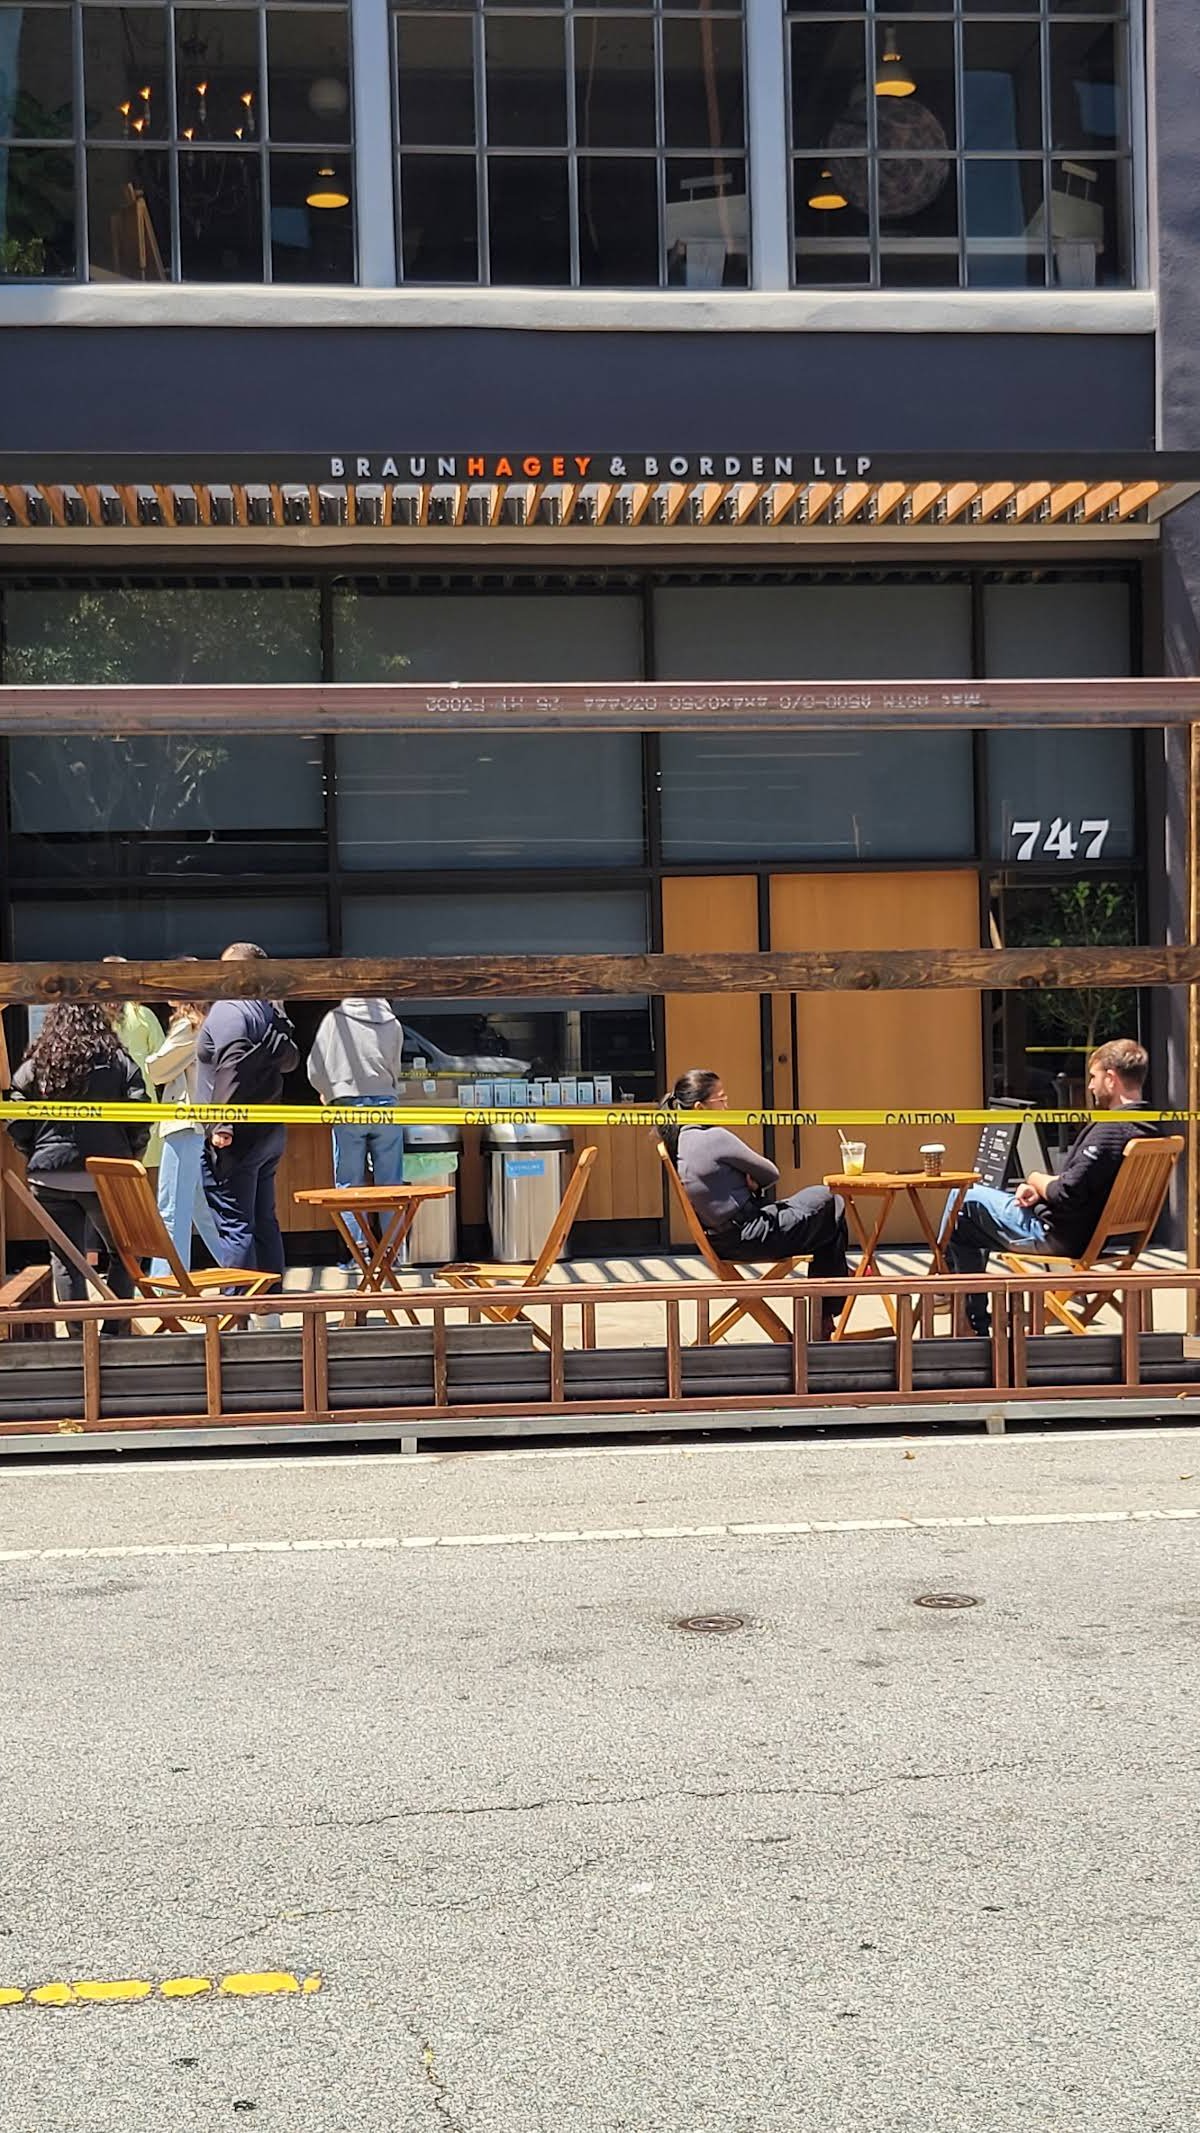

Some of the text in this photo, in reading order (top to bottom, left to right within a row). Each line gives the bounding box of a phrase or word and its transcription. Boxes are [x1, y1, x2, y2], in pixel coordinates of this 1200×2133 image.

[609, 457, 627, 477] &
[645, 457, 794, 477] BORDEN
[814, 457, 872, 476] LLP
[1011, 816, 1110, 861] 747
[27, 1105, 103, 1119] CAUTION
[174, 1107, 249, 1121] CAUTION
[320, 1110, 394, 1125] CAUTION
[464, 1111, 537, 1125] CAUTION
[606, 1112, 678, 1125] CAUTION
[746, 1113, 818, 1125] CAUTION
[885, 1113, 956, 1125] CAUTION
[1022, 1112, 1092, 1123] CAUTION
